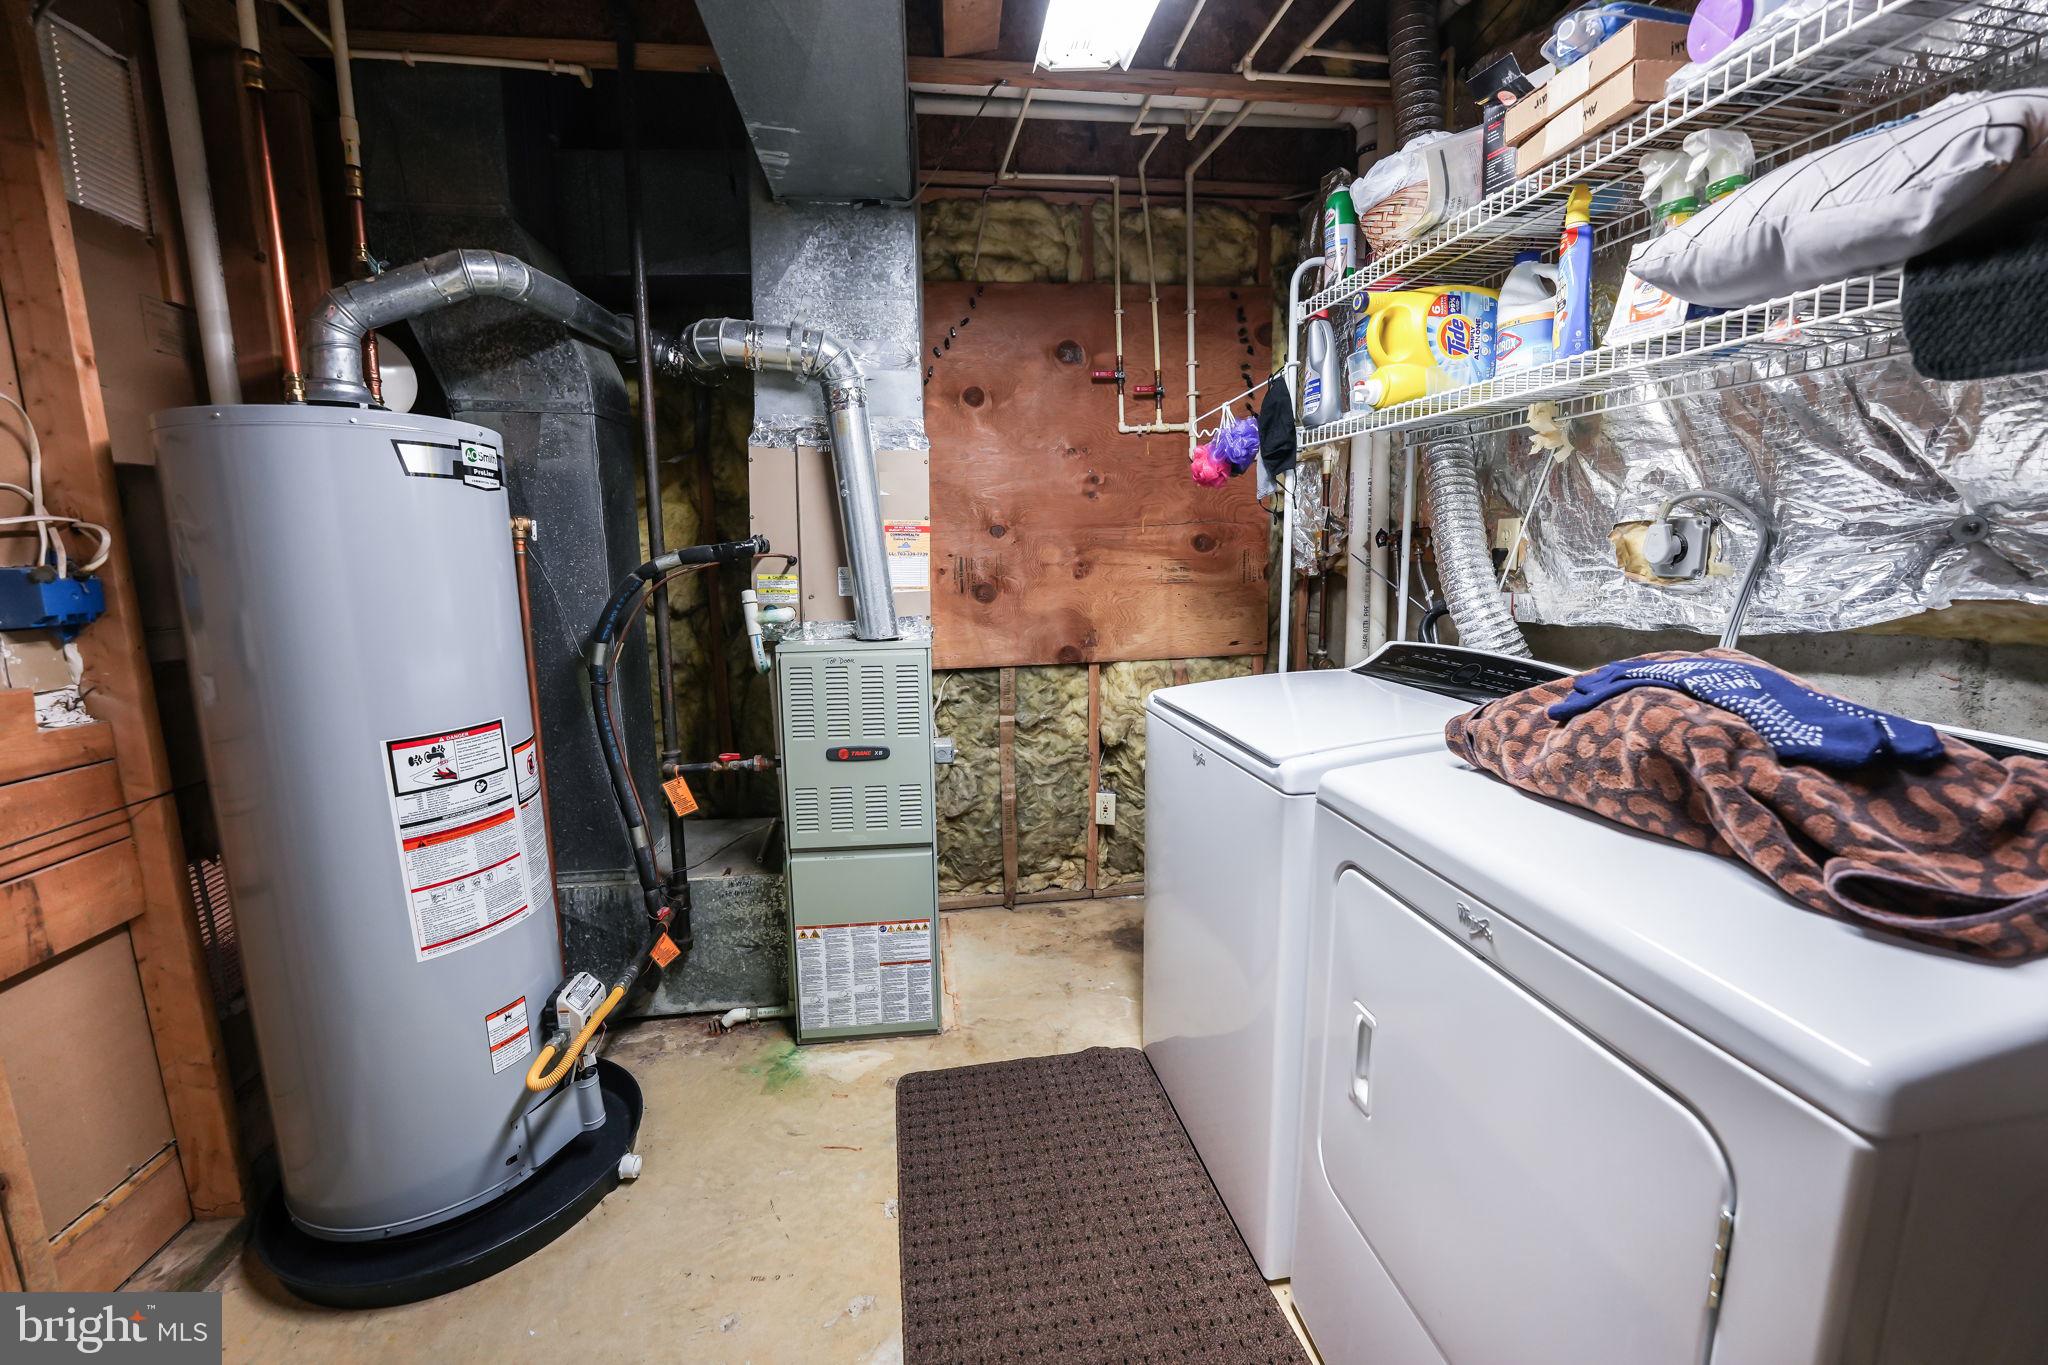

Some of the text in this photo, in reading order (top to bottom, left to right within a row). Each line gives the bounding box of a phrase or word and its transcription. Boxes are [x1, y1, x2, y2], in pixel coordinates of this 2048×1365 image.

[1432, 305, 1441, 315] 6
[1447, 318, 1469, 355] Tide
[478, 452, 497, 465] Smith
[446, 732, 469, 740] DANGER
